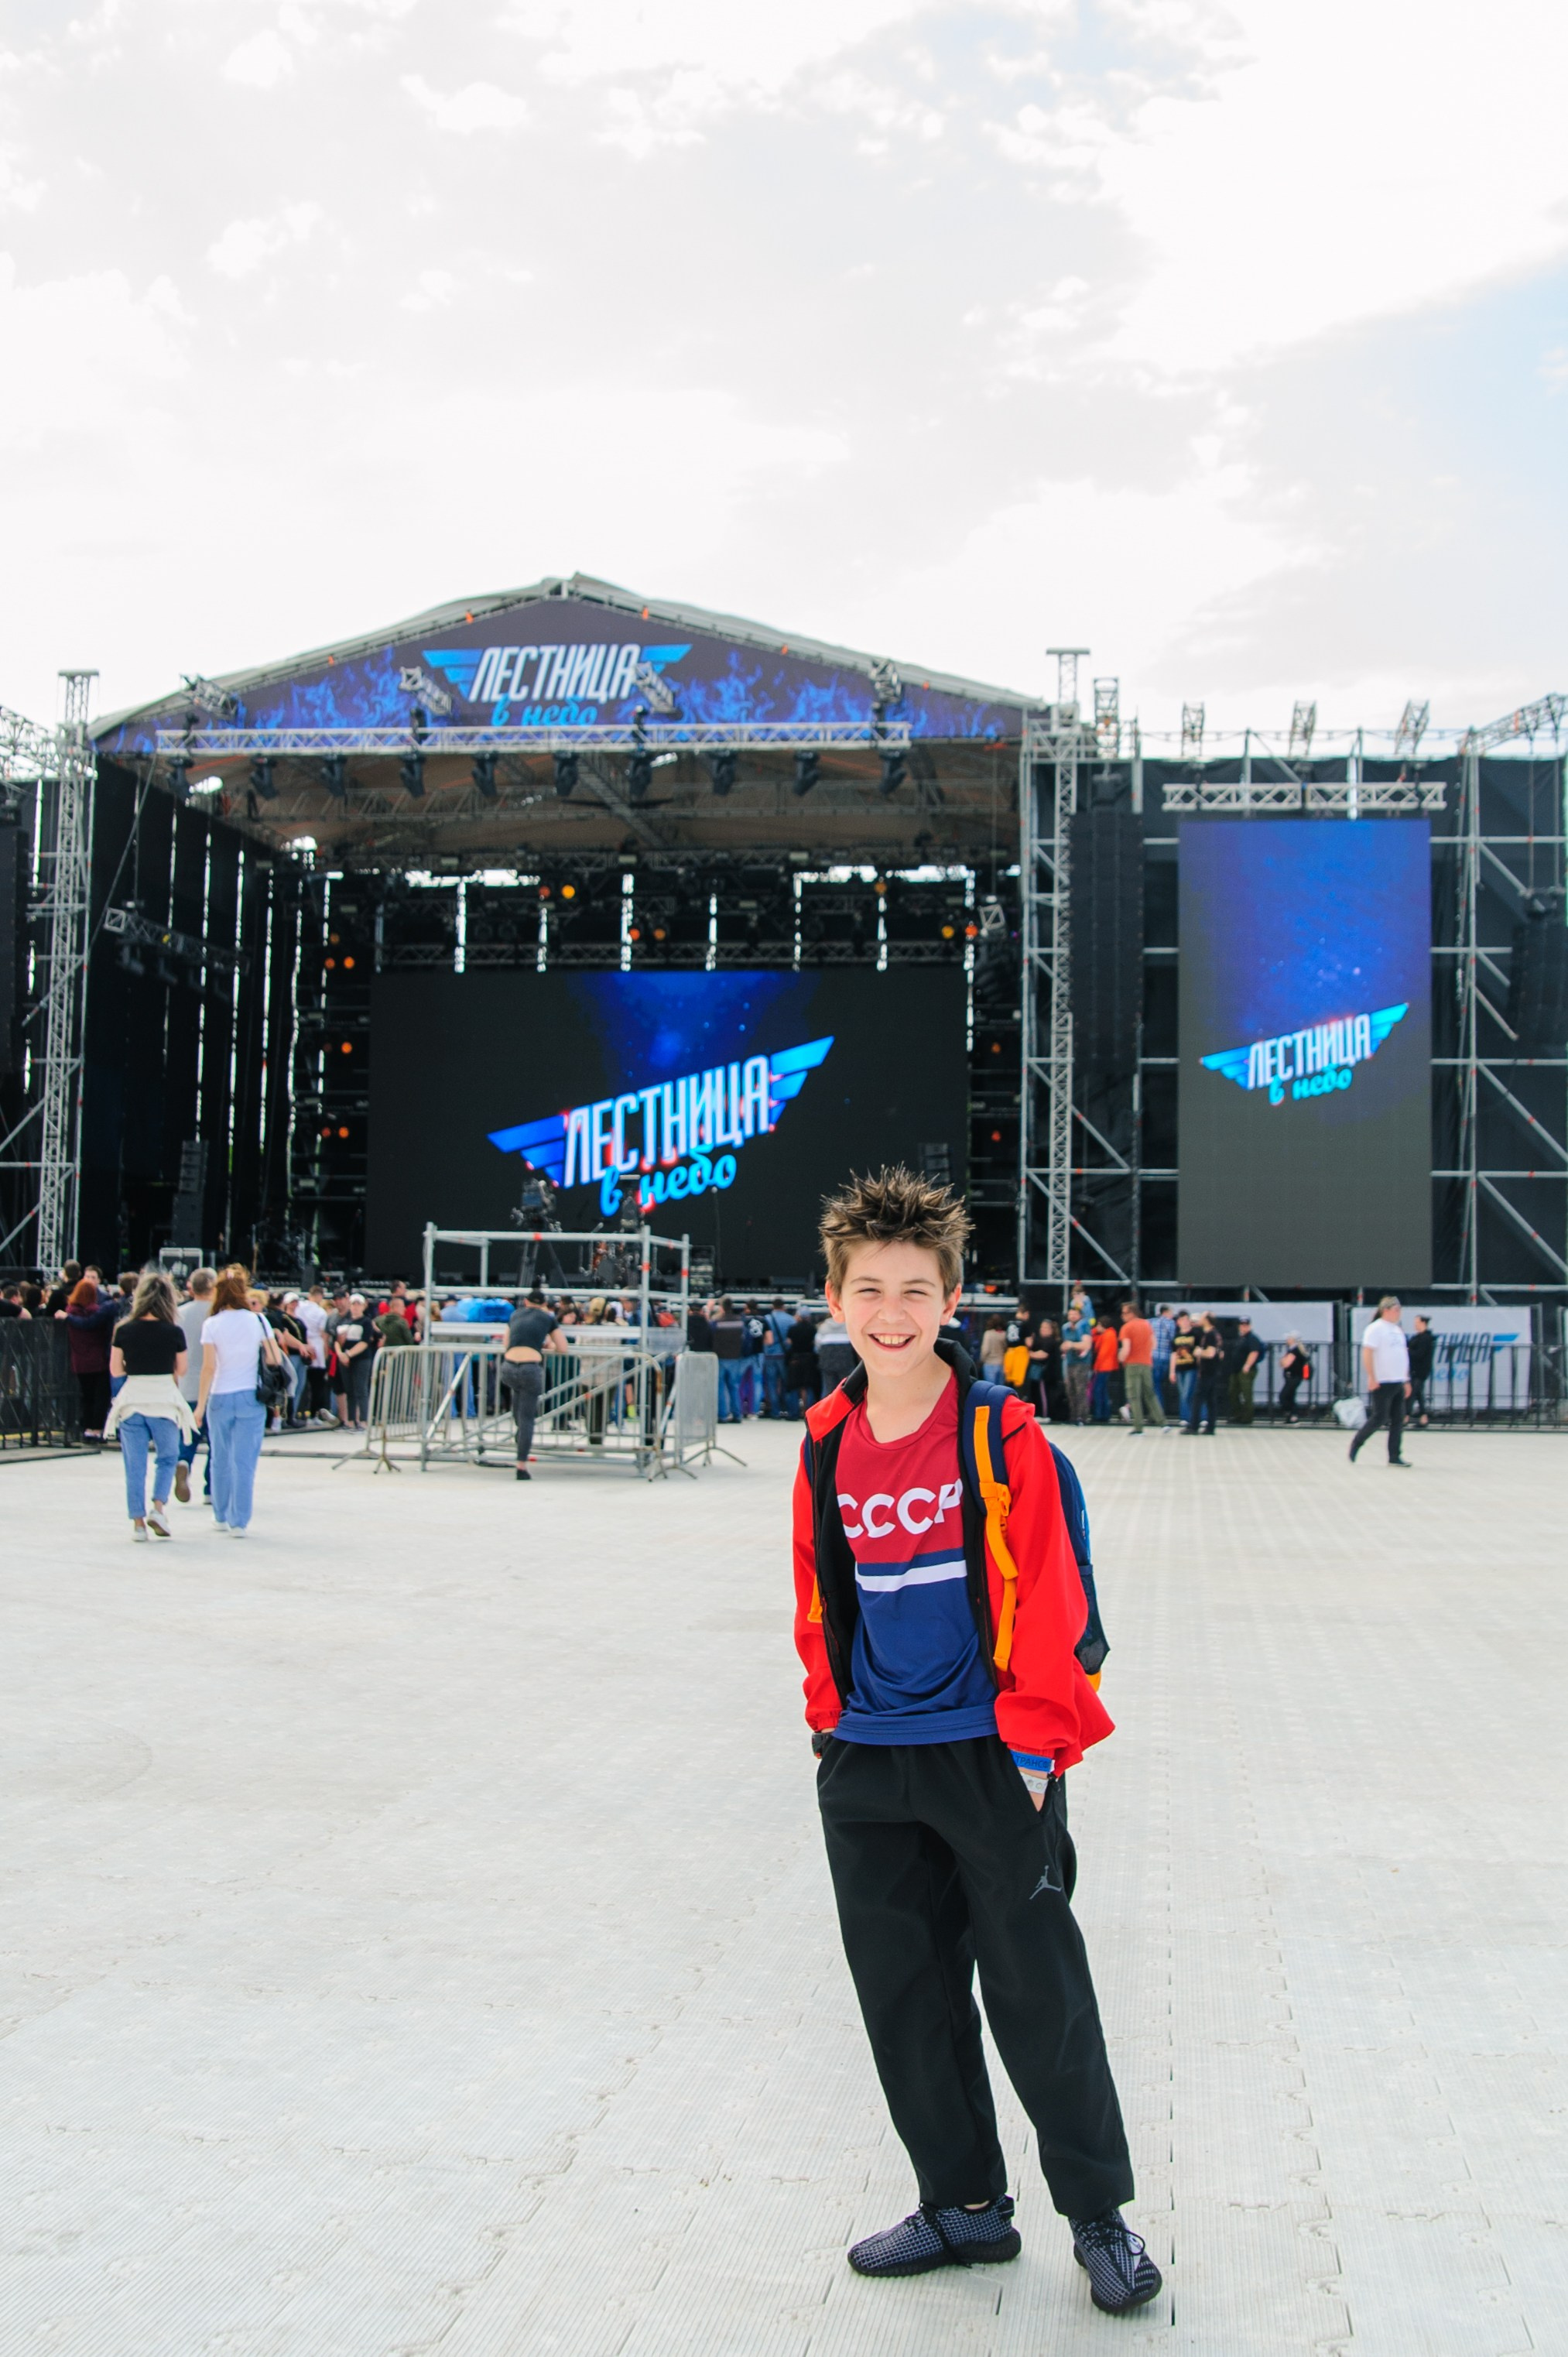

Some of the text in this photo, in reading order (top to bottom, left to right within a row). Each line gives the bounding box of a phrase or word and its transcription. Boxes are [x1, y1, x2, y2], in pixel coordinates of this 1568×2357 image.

[469, 643, 642, 704] ЛЕСТНИЦА
[491, 694, 597, 727] в небо
[1248, 1013, 1371, 1090] ЛЕСТНИЦА
[1269, 1063, 1353, 1106] в небо
[564, 1054, 770, 1189] ЛЕСТНИЦА
[600, 1144, 737, 1217] в небо
[837, 1478, 964, 1538] СССР
